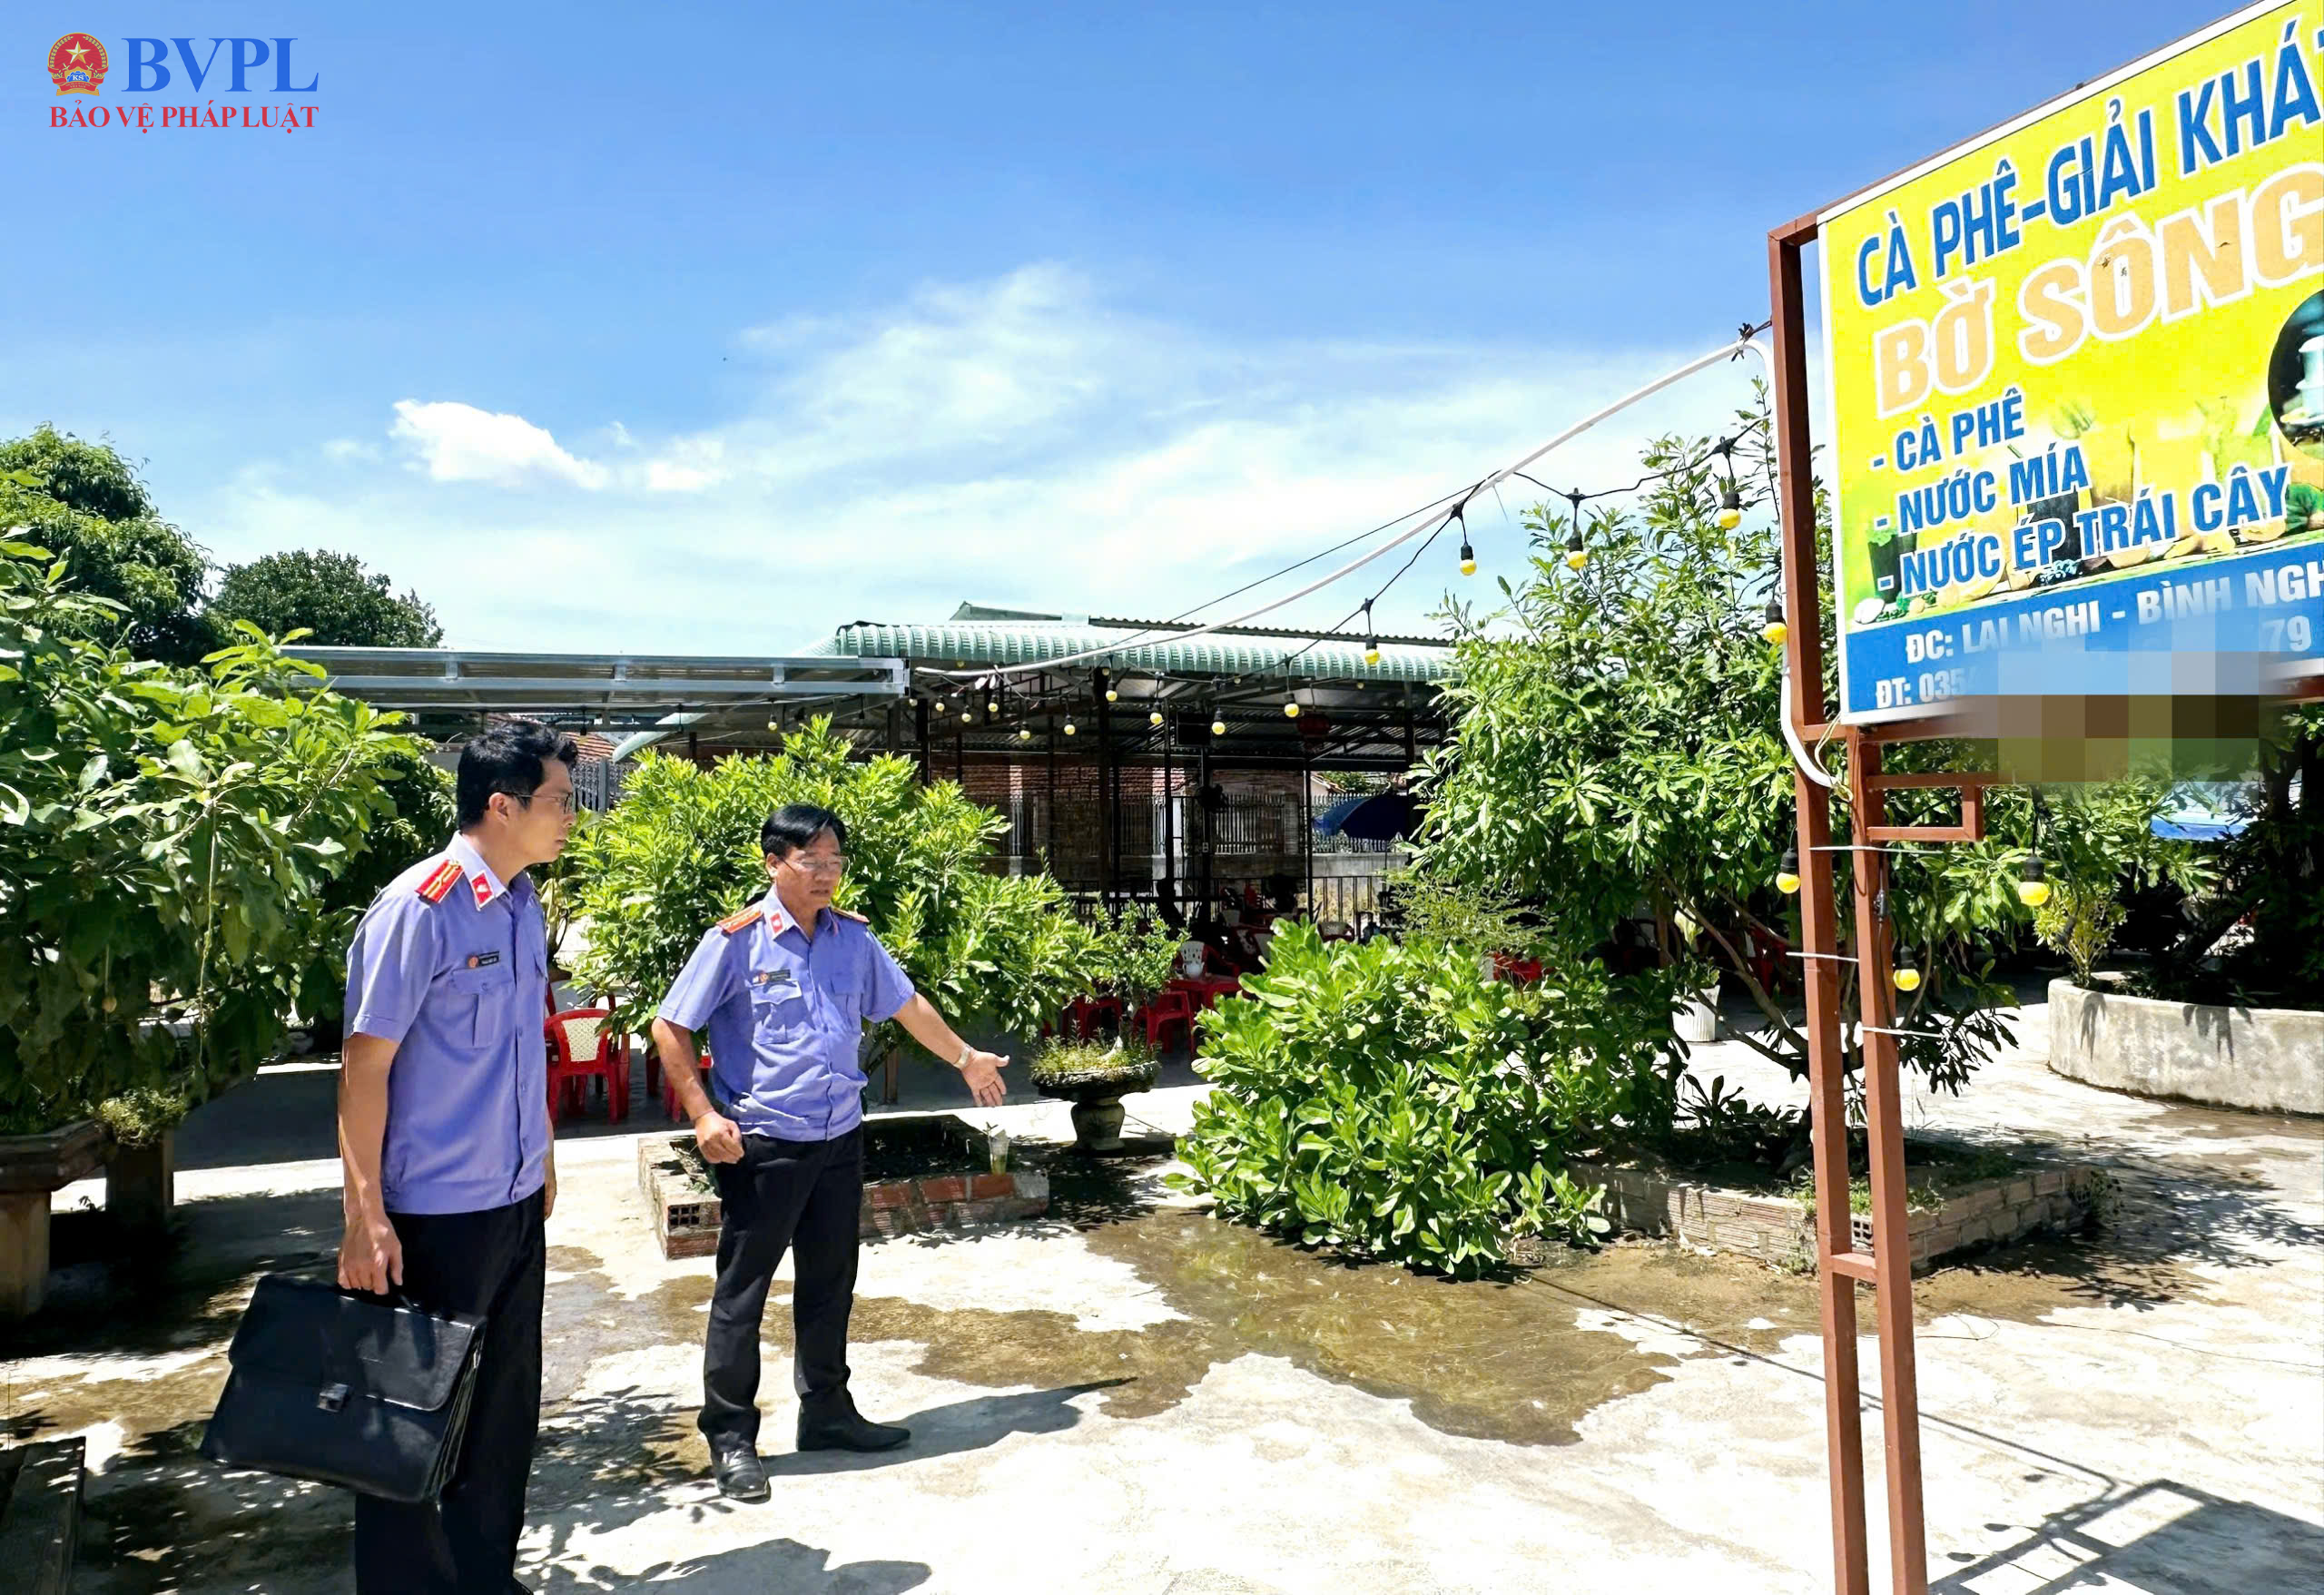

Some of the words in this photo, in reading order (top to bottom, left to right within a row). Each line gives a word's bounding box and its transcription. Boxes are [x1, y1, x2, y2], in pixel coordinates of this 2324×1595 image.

[1857, 211, 1917, 307] CÀ
[2178, 18, 2324, 175] KHÁ
[1878, 283, 1993, 412] BỜ
[2022, 167, 2324, 360] SÔNG
[1895, 415, 1944, 471] CÀ
[1952, 387, 2026, 454] PHÊ
[1897, 468, 1996, 535] NƯỚC
[2008, 441, 2090, 507] MÍA
[1903, 533, 2001, 594] NƯỚC
[2013, 518, 2065, 572] ÉP
[2075, 486, 2177, 559] TRÁI
[2191, 464, 2290, 531] CÂY
[1905, 629, 1953, 664] ĐC:
[2018, 600, 2101, 643] NGHI
[2136, 580, 2232, 625] BÌNH
[1876, 676, 1911, 708] ĐT:
